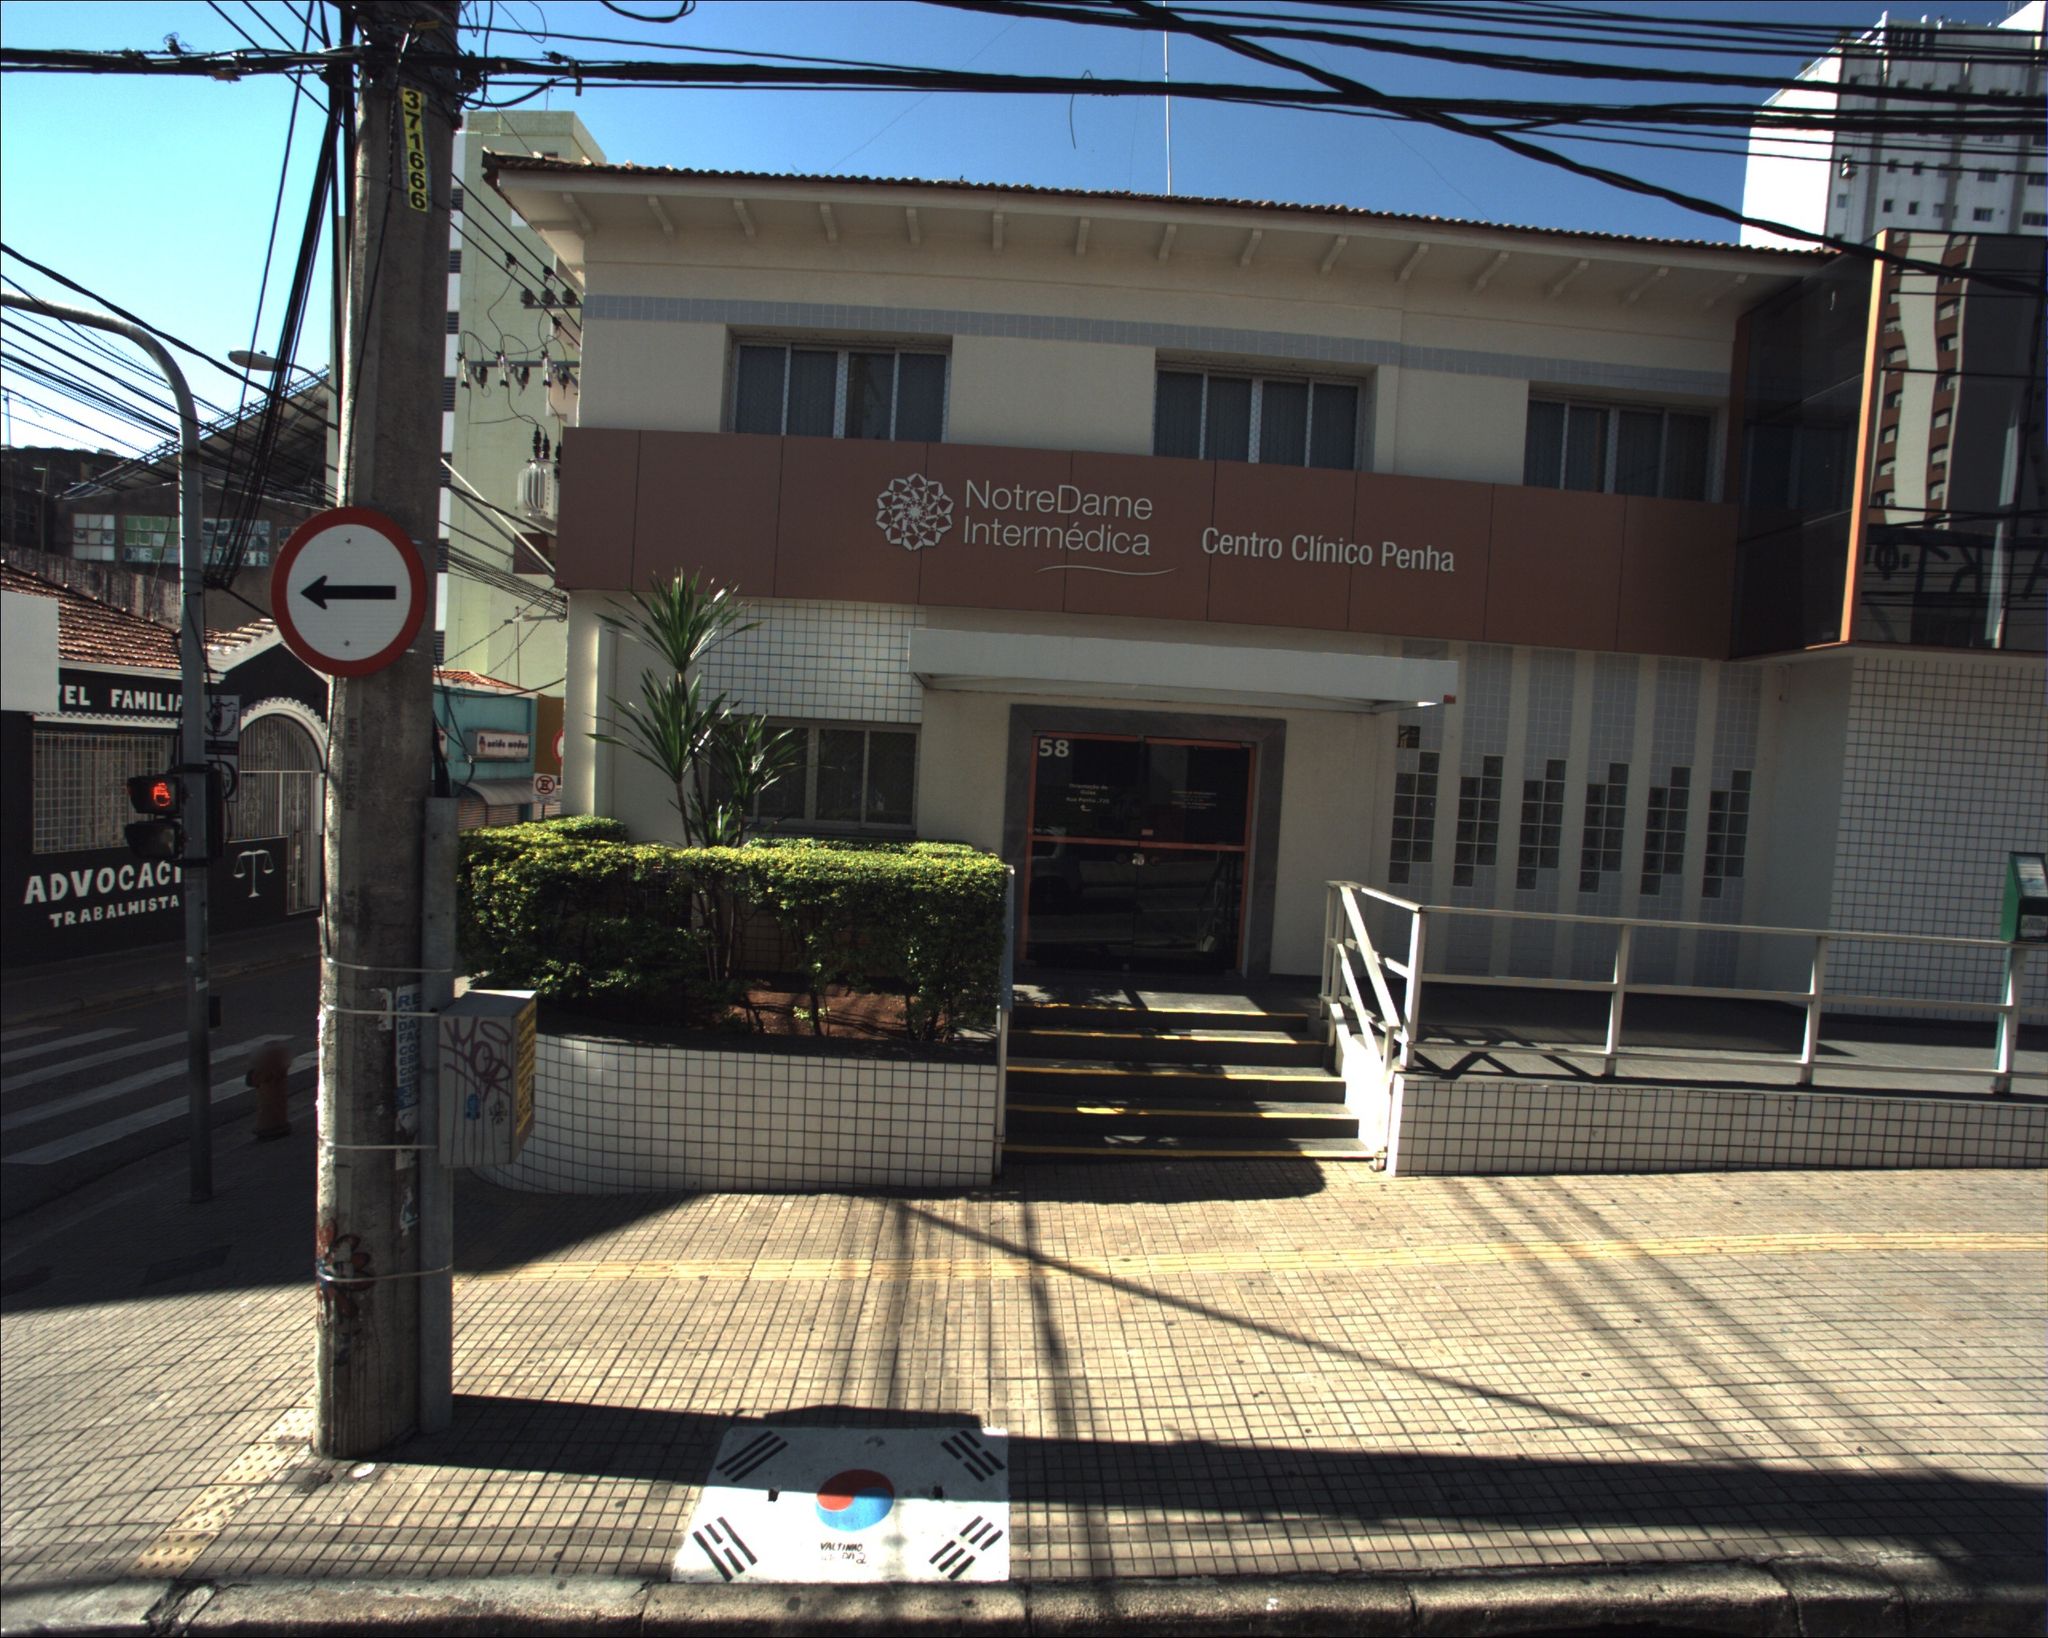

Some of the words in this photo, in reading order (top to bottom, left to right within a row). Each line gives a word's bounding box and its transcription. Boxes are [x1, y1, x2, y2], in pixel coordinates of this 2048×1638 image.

[404, 90, 426, 210] 371666
[965, 477, 1154, 521] NotreDame
[963, 517, 1152, 559] Intermédica
[1201, 526, 1283, 558] Centro
[1291, 531, 1374, 567] Clínico
[1381, 540, 1456, 573] Penha
[59, 685, 91, 707] EL
[1038, 738, 1070, 758] 58
[23, 860, 182, 905] ADVOCACI
[48, 894, 180, 928] TRABALHISTA
